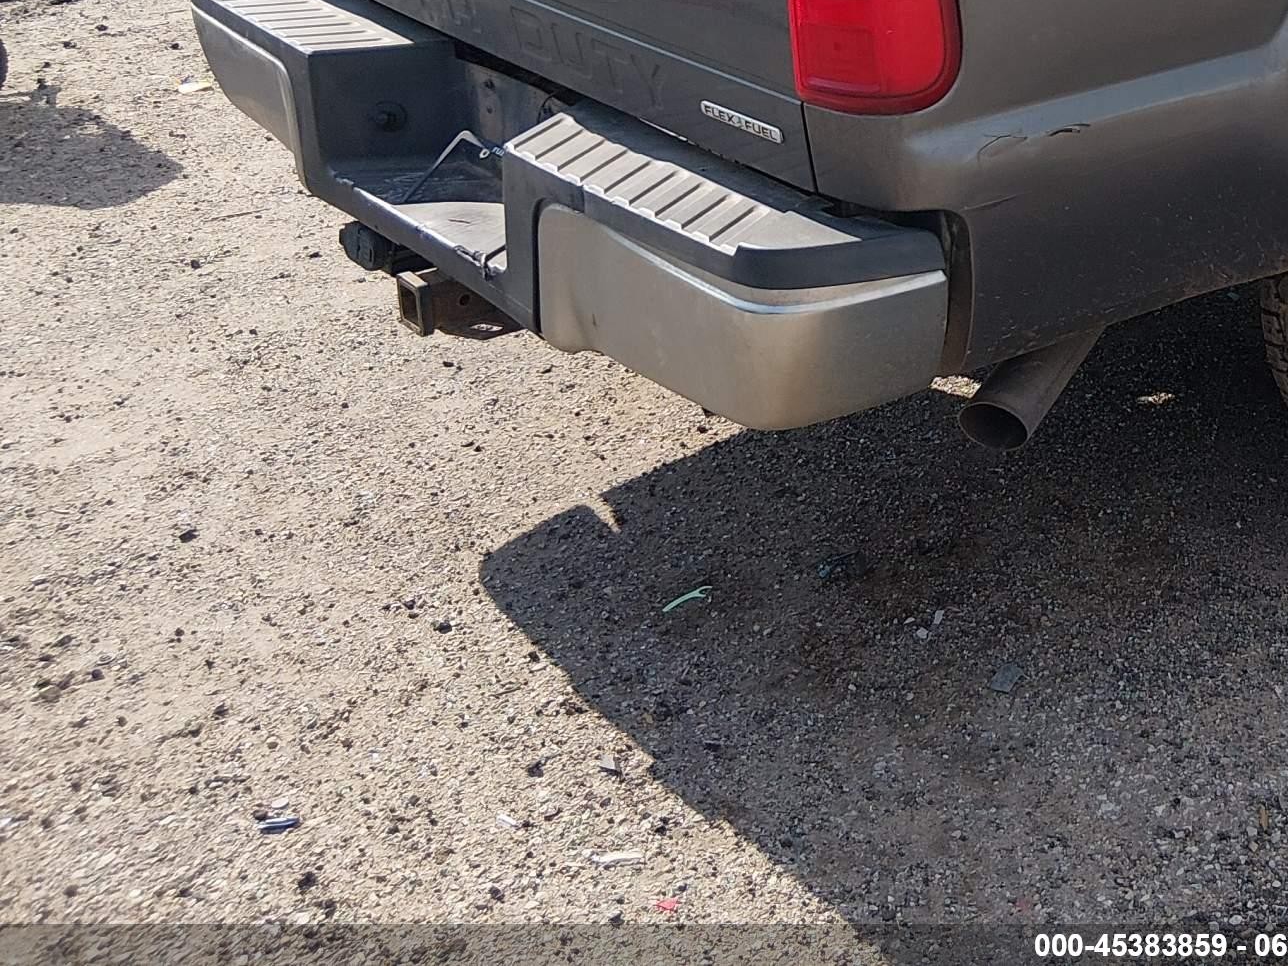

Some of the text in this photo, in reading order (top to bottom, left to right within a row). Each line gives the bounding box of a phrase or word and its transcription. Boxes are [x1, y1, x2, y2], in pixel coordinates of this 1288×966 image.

[510, 6, 665, 111] DUTY
[703, 105, 778, 141] FLEX FUEL
